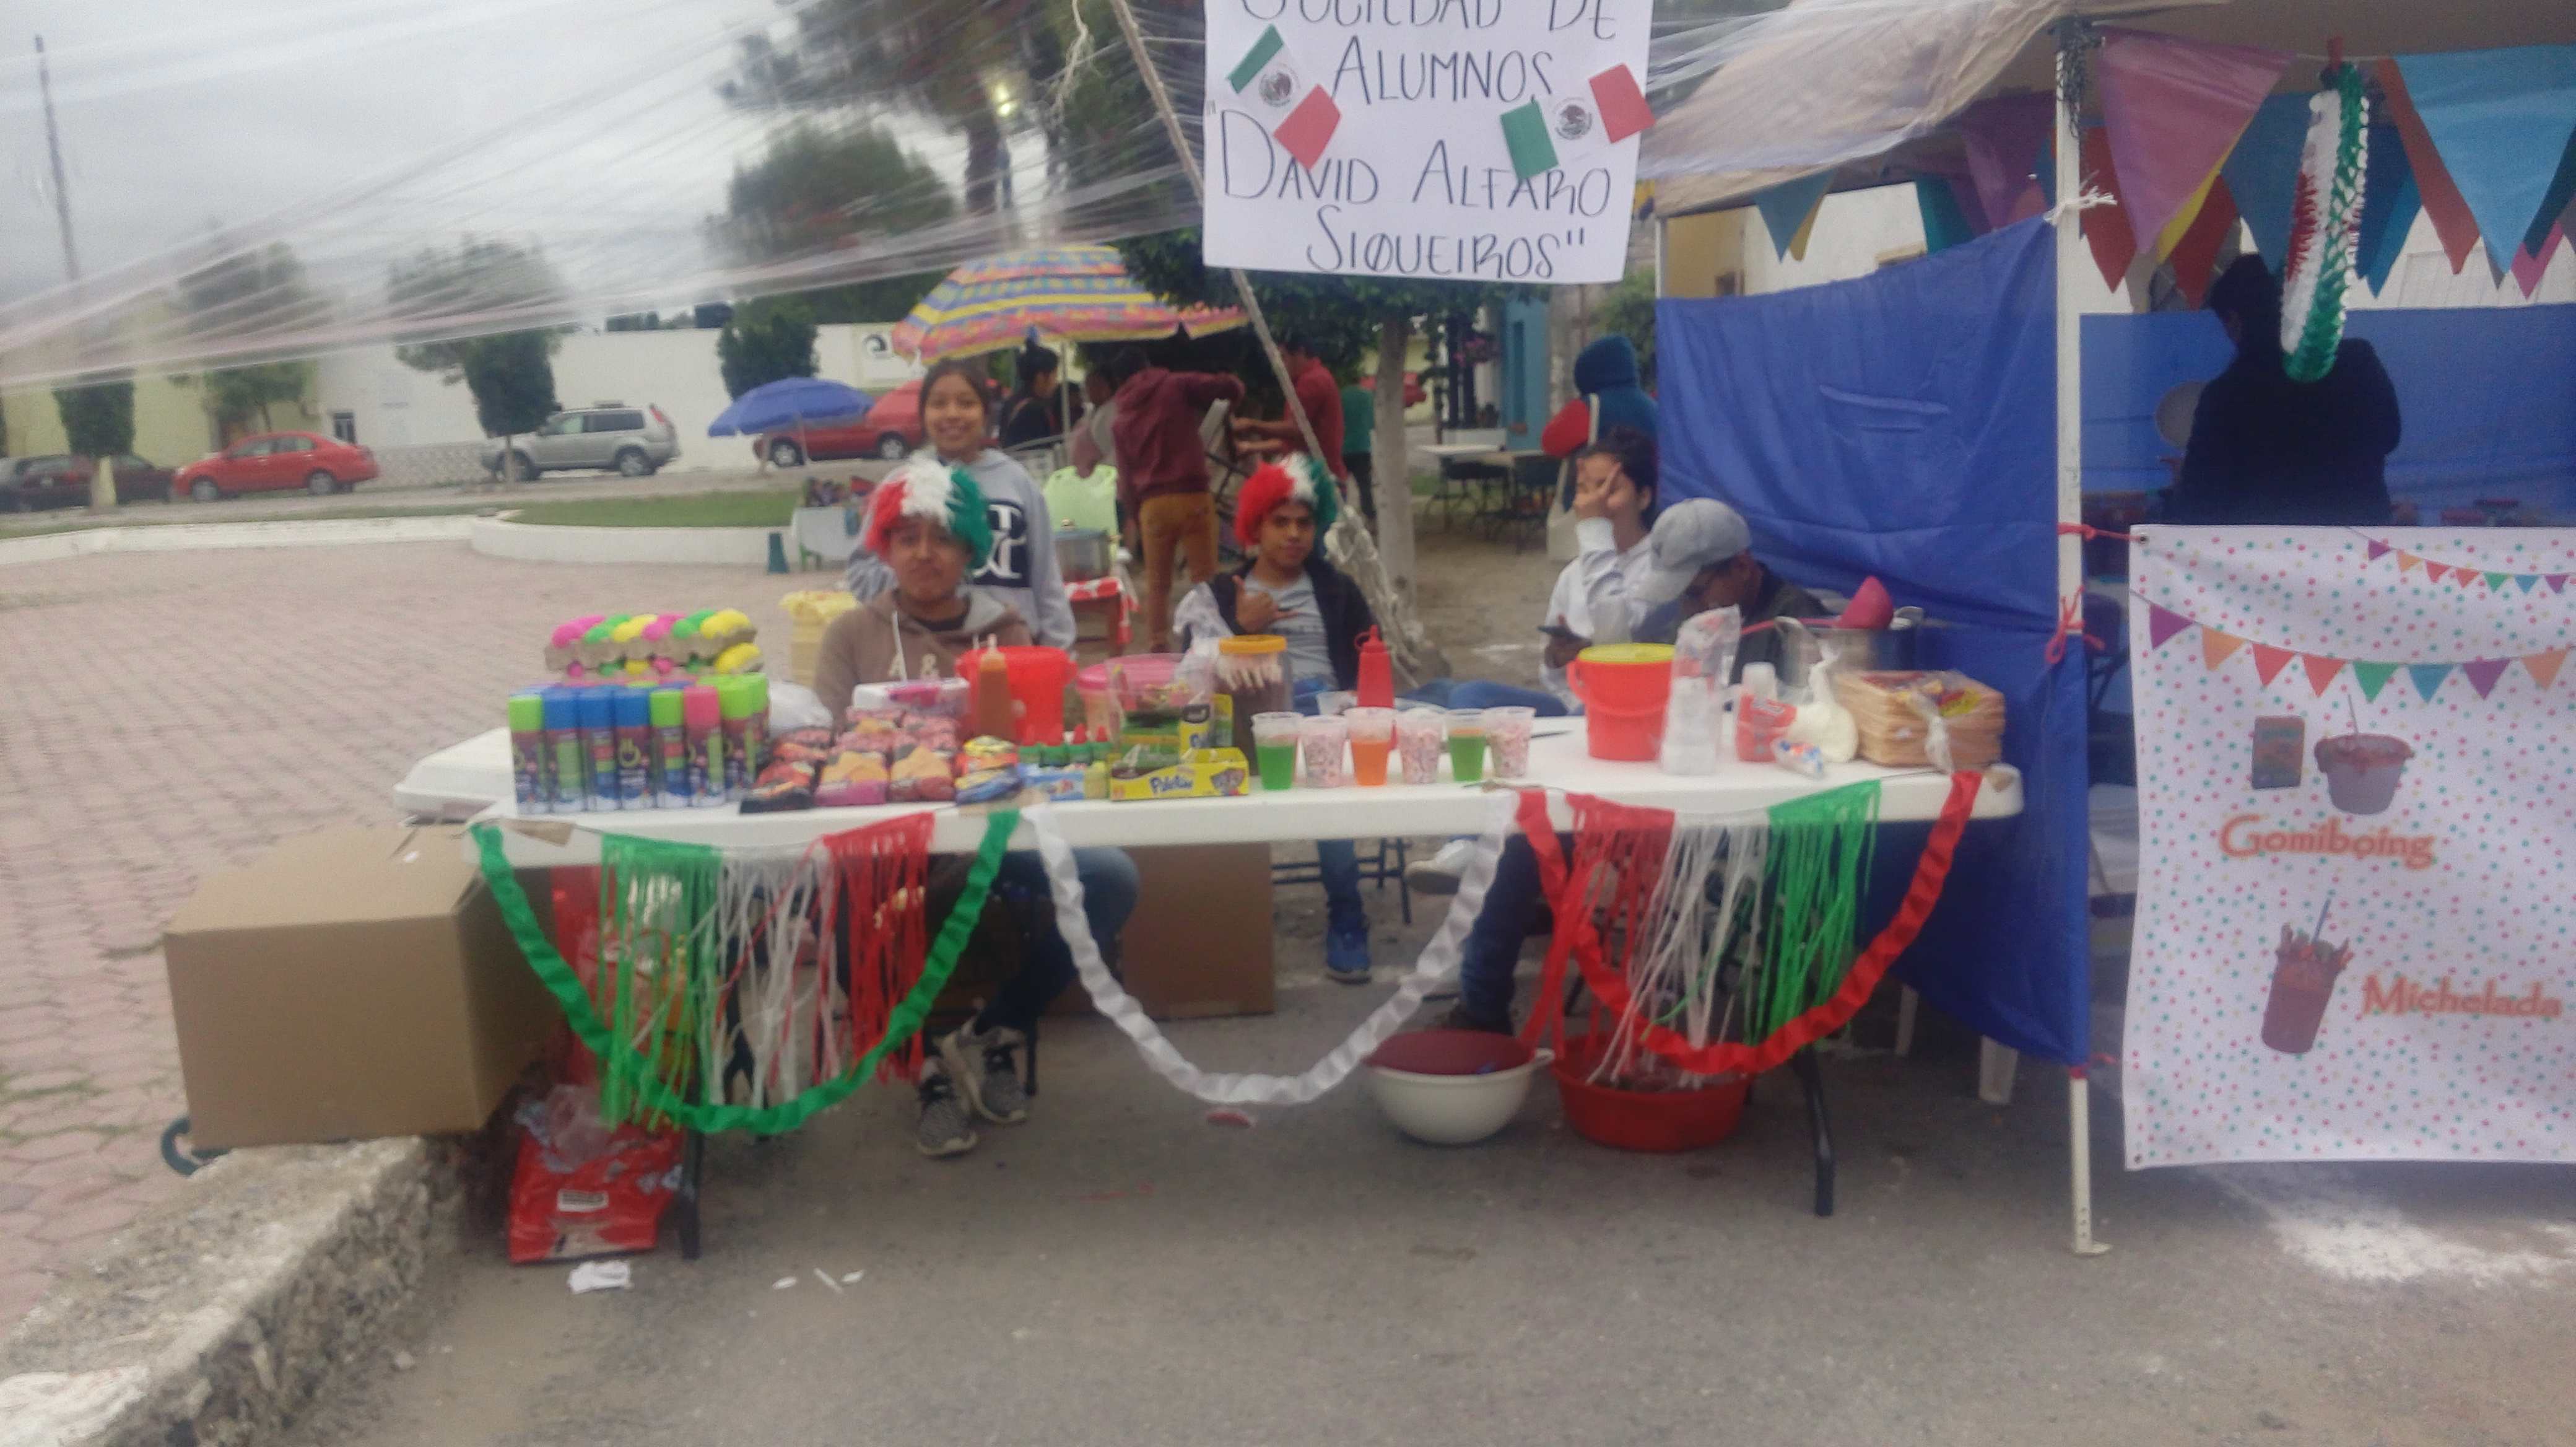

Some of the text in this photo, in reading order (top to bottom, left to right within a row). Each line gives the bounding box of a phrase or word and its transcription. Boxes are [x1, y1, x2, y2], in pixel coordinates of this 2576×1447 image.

[1549, 0, 1616, 40] DE
[1331, 34, 1553, 105] ALUMNOS
[1411, 138, 1611, 217] ALFARO
[2219, 813, 2436, 870] Gomiboing
[2361, 974, 2562, 1018] Michelada
